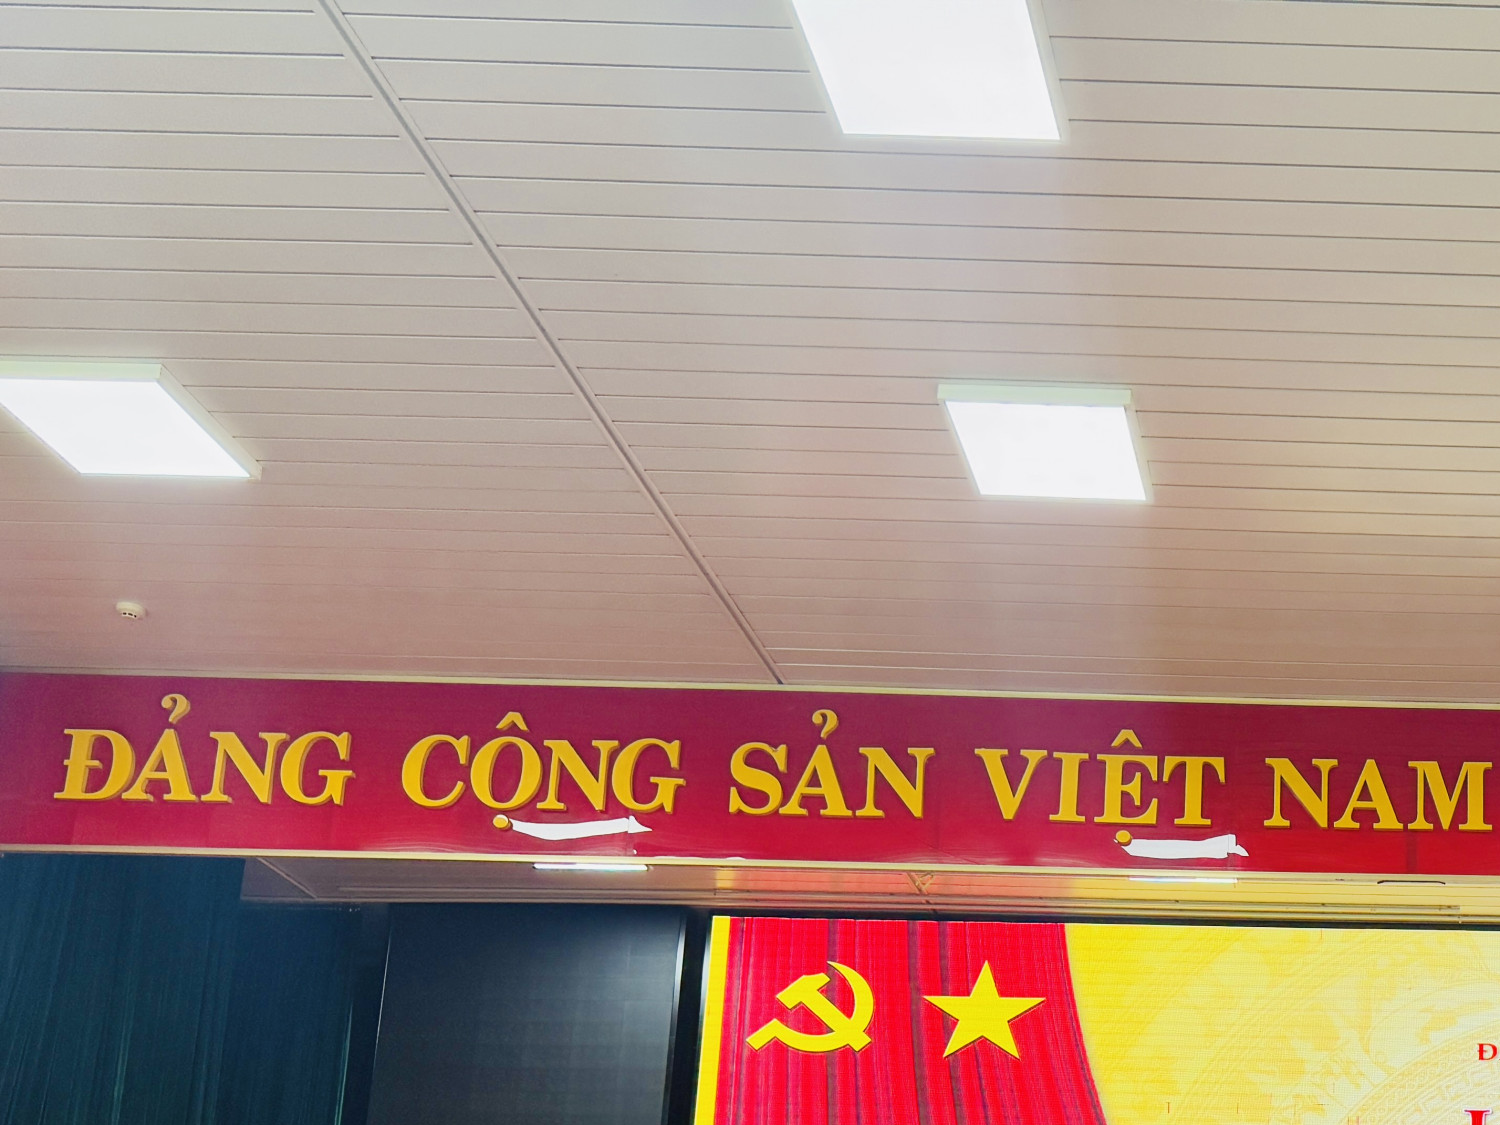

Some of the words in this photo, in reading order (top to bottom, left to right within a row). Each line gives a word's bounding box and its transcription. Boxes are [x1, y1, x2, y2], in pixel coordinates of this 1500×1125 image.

[53, 693, 354, 806] ĐẢNG
[401, 711, 686, 830] CỘNG
[728, 708, 934, 819] SẢN
[975, 728, 1226, 845] VIỆT
[1264, 757, 1493, 831] NAM
